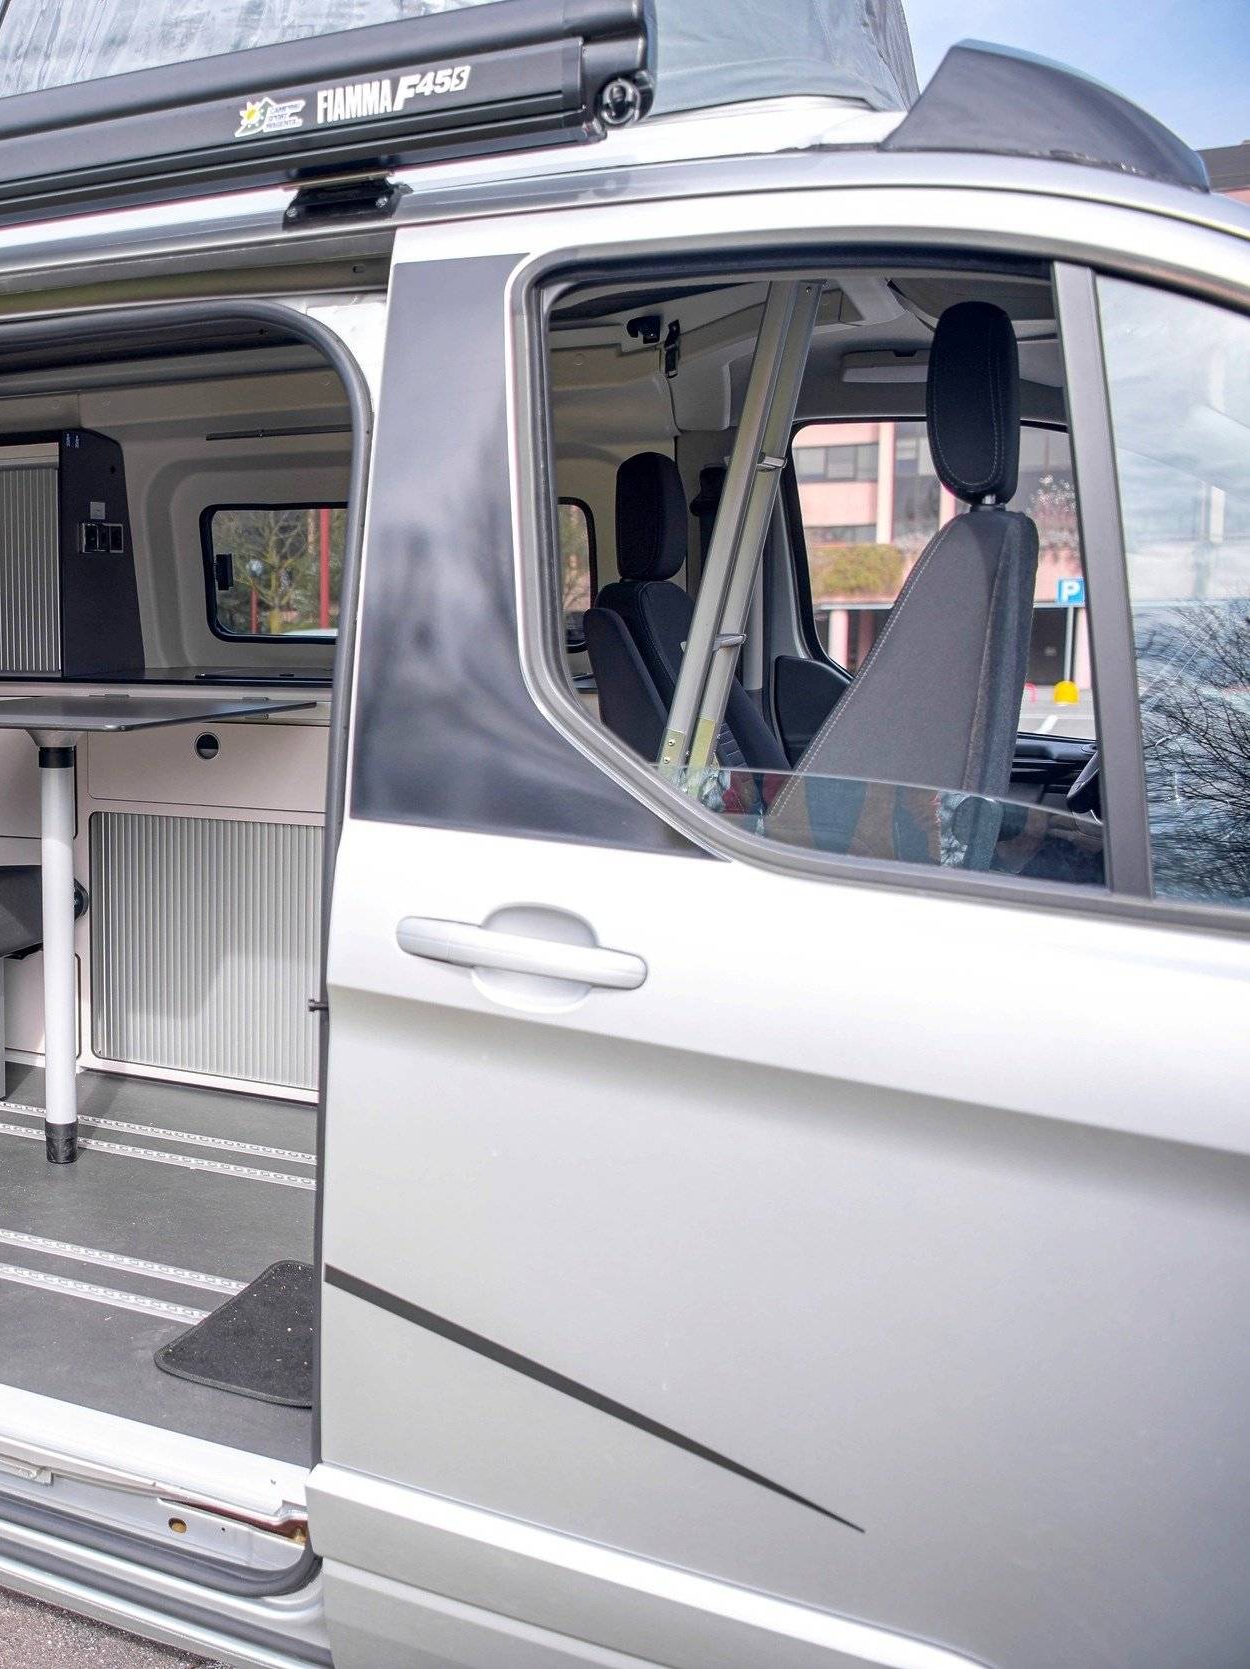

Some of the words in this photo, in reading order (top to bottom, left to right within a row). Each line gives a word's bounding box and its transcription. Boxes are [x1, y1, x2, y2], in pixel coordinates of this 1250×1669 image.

[317, 79, 392, 124] FIAMMA
[393, 65, 471, 111] F45S
[1061, 582, 1080, 603] P
